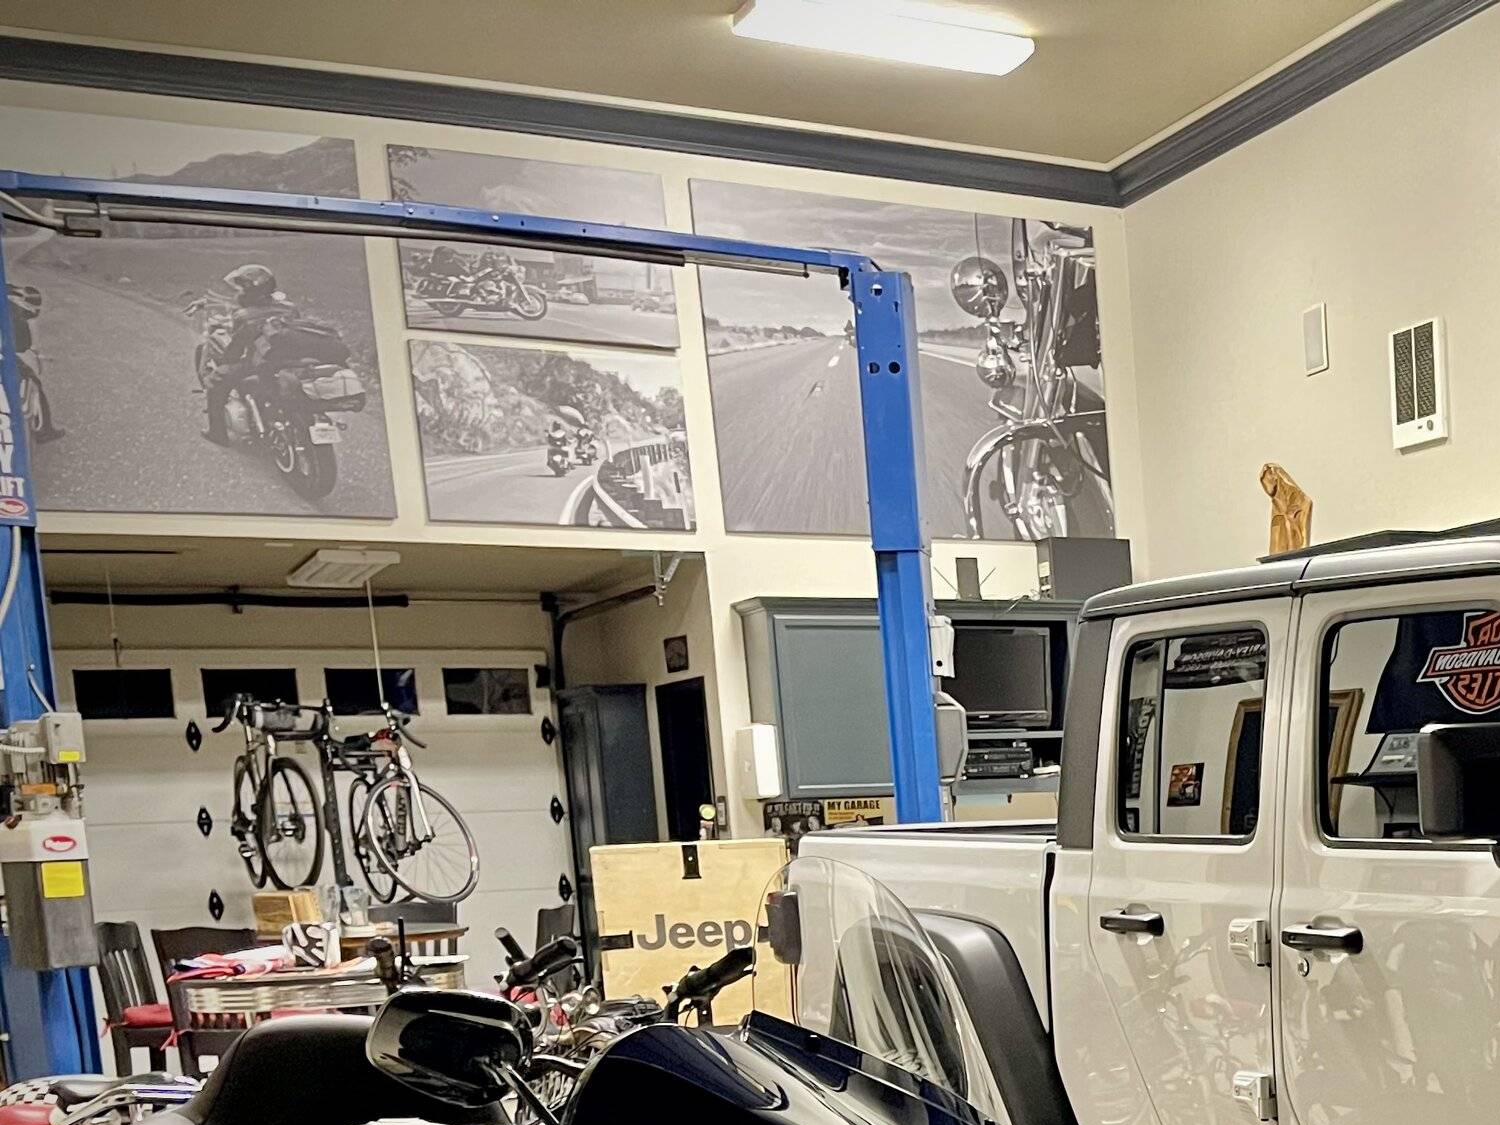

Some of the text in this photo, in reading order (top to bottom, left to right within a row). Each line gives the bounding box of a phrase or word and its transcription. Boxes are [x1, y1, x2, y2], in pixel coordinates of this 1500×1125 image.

[0, 475, 25, 498] IFT
[827, 800, 880, 811] MY GARAGE
[637, 914, 753, 956] Jeep
